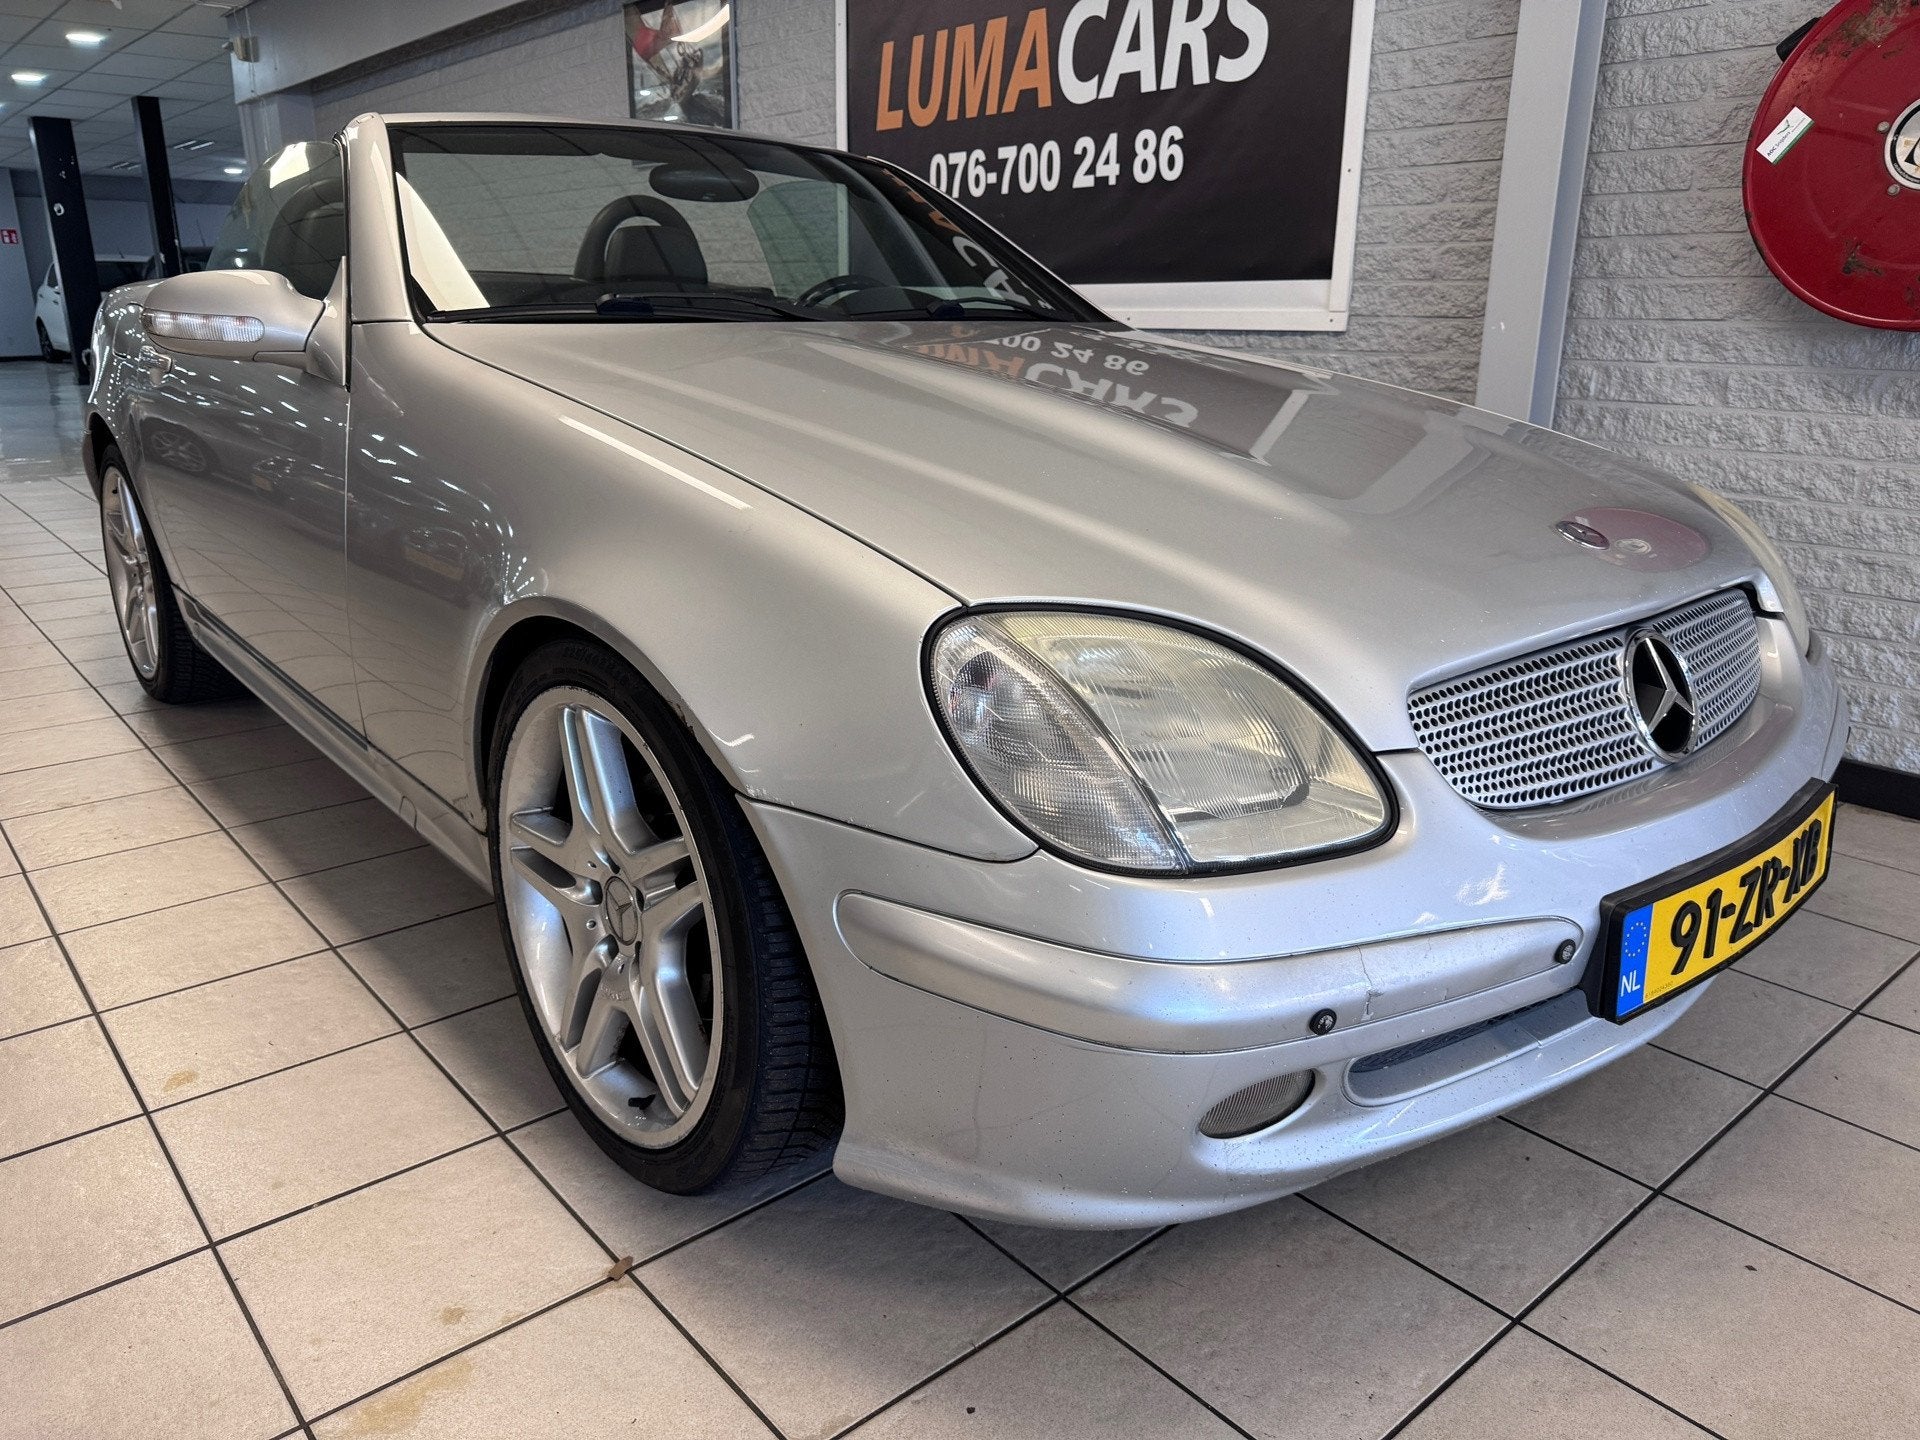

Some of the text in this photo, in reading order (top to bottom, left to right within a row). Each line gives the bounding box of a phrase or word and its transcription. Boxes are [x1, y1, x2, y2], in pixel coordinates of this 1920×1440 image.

[930, 125, 1184, 198] 076-700 24 86
[1671, 819, 1822, 976] 91-ZR-XB
[1620, 969, 1641, 997] NL
